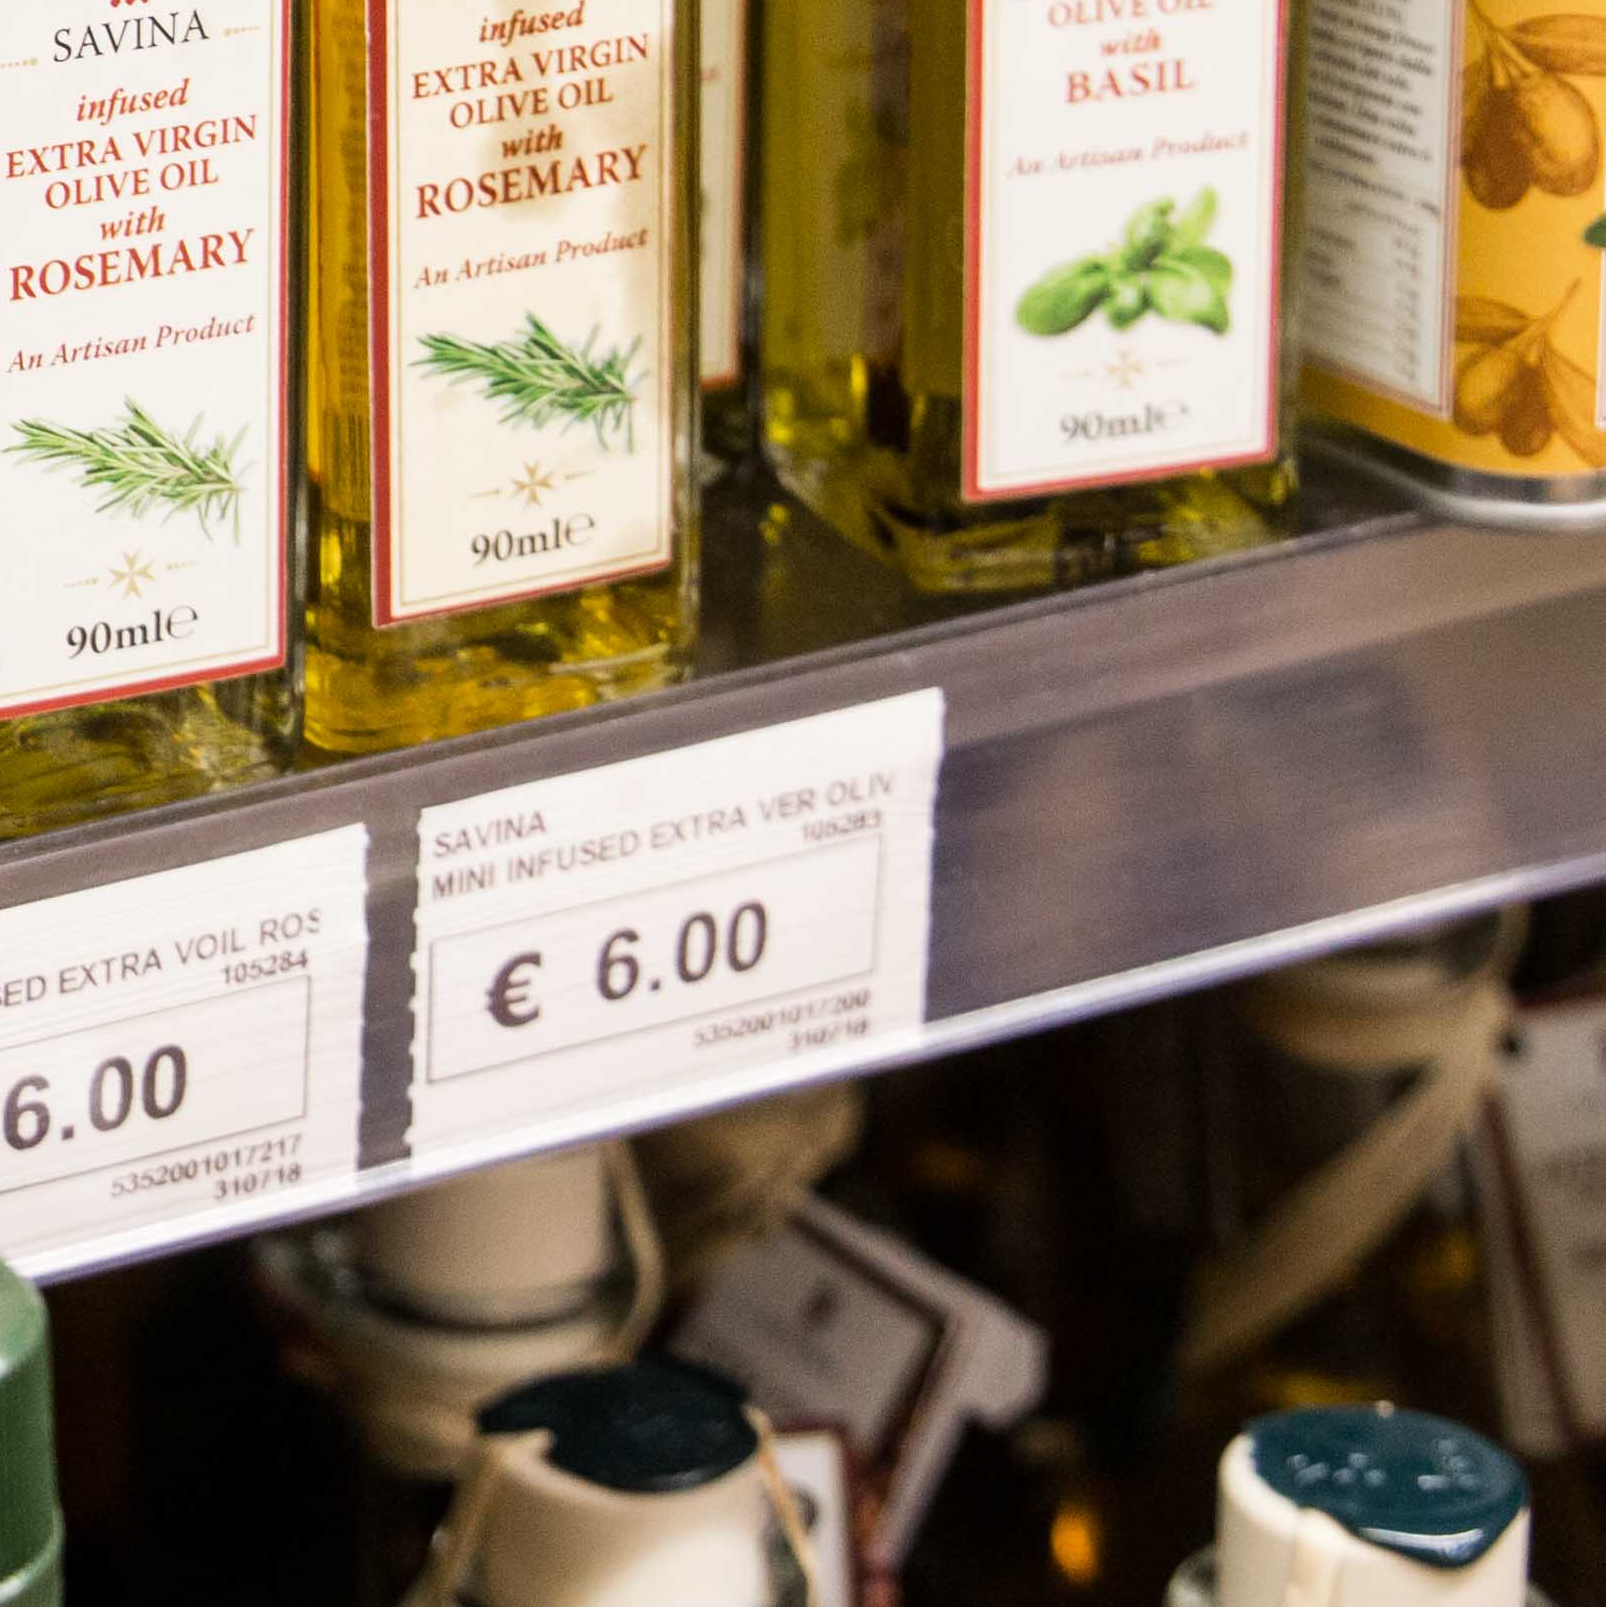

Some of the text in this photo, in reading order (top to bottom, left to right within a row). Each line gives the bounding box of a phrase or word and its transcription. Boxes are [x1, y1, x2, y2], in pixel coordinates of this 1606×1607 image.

[53, 9, 210, 64] SAVINA
[478, 0, 585, 47] infused
[1102, 28, 1162, 57] with
[411, 34, 650, 99] EXTRA VIRGIN
[1066, 58, 1195, 105] BASIL
[76, 78, 190, 125] infused
[449, 77, 614, 129] OLIVE OIL
[5, 115, 259, 179] EXTRA VIRGIN
[501, 124, 563, 160] with
[45, 158, 219, 210] OLIVE OIL
[415, 144, 648, 219] ROSEMARY
[100, 206, 166, 241] with
[10, 228, 256, 302] ROSEMARY
[414, 228, 649, 289] An Artisan Product
[6, 313, 256, 374] An Artisan Product
[431, 863, 497, 899] MINI
[507, 830, 641, 884] INFUSED
[650, 807, 748, 848] EXTRA
[757, 787, 816, 822] VER
[434, 809, 547, 859] SAVINA
[57, 948, 164, 995] EXTRA
[174, 926, 247, 967] VOIL
[258, 907, 322, 945] ROS
[221, 948, 309, 986] 105284
[485, 898, 769, 1029] € 6.00
[2, 1043, 188, 1151] 6.00
